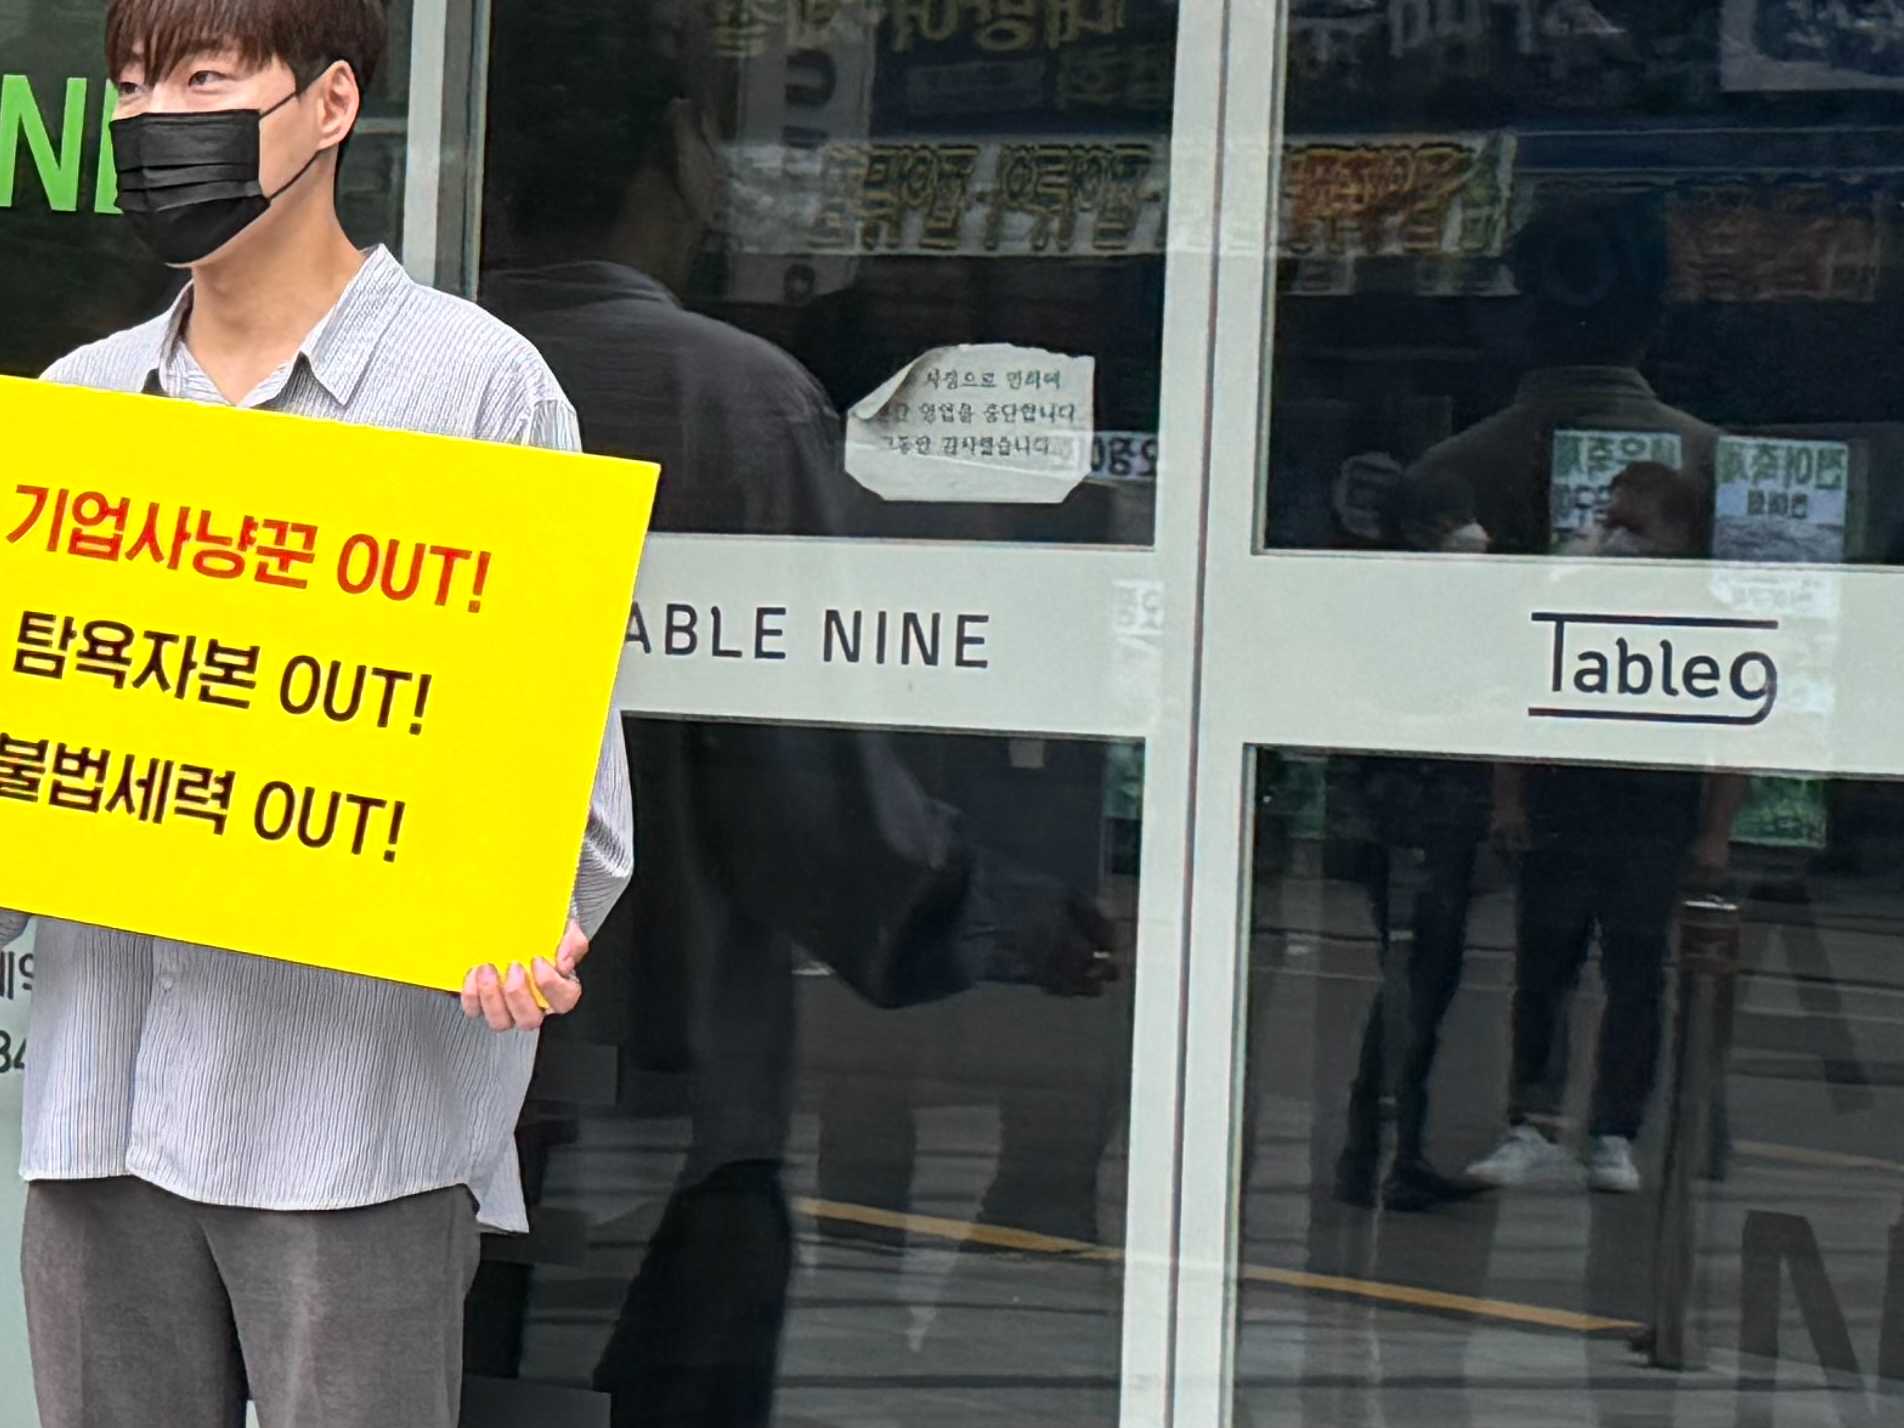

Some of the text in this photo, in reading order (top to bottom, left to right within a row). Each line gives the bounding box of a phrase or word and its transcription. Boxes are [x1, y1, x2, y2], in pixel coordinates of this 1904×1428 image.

[5, 482, 493, 614] 기업사냥꾼 OUT!
[12, 609, 432, 736] 탐욕자본 OUT!
[625, 601, 991, 669] ABLE NINE
[1527, 610, 1779, 725] Table9
[253, 778, 407, 864] OUT!
